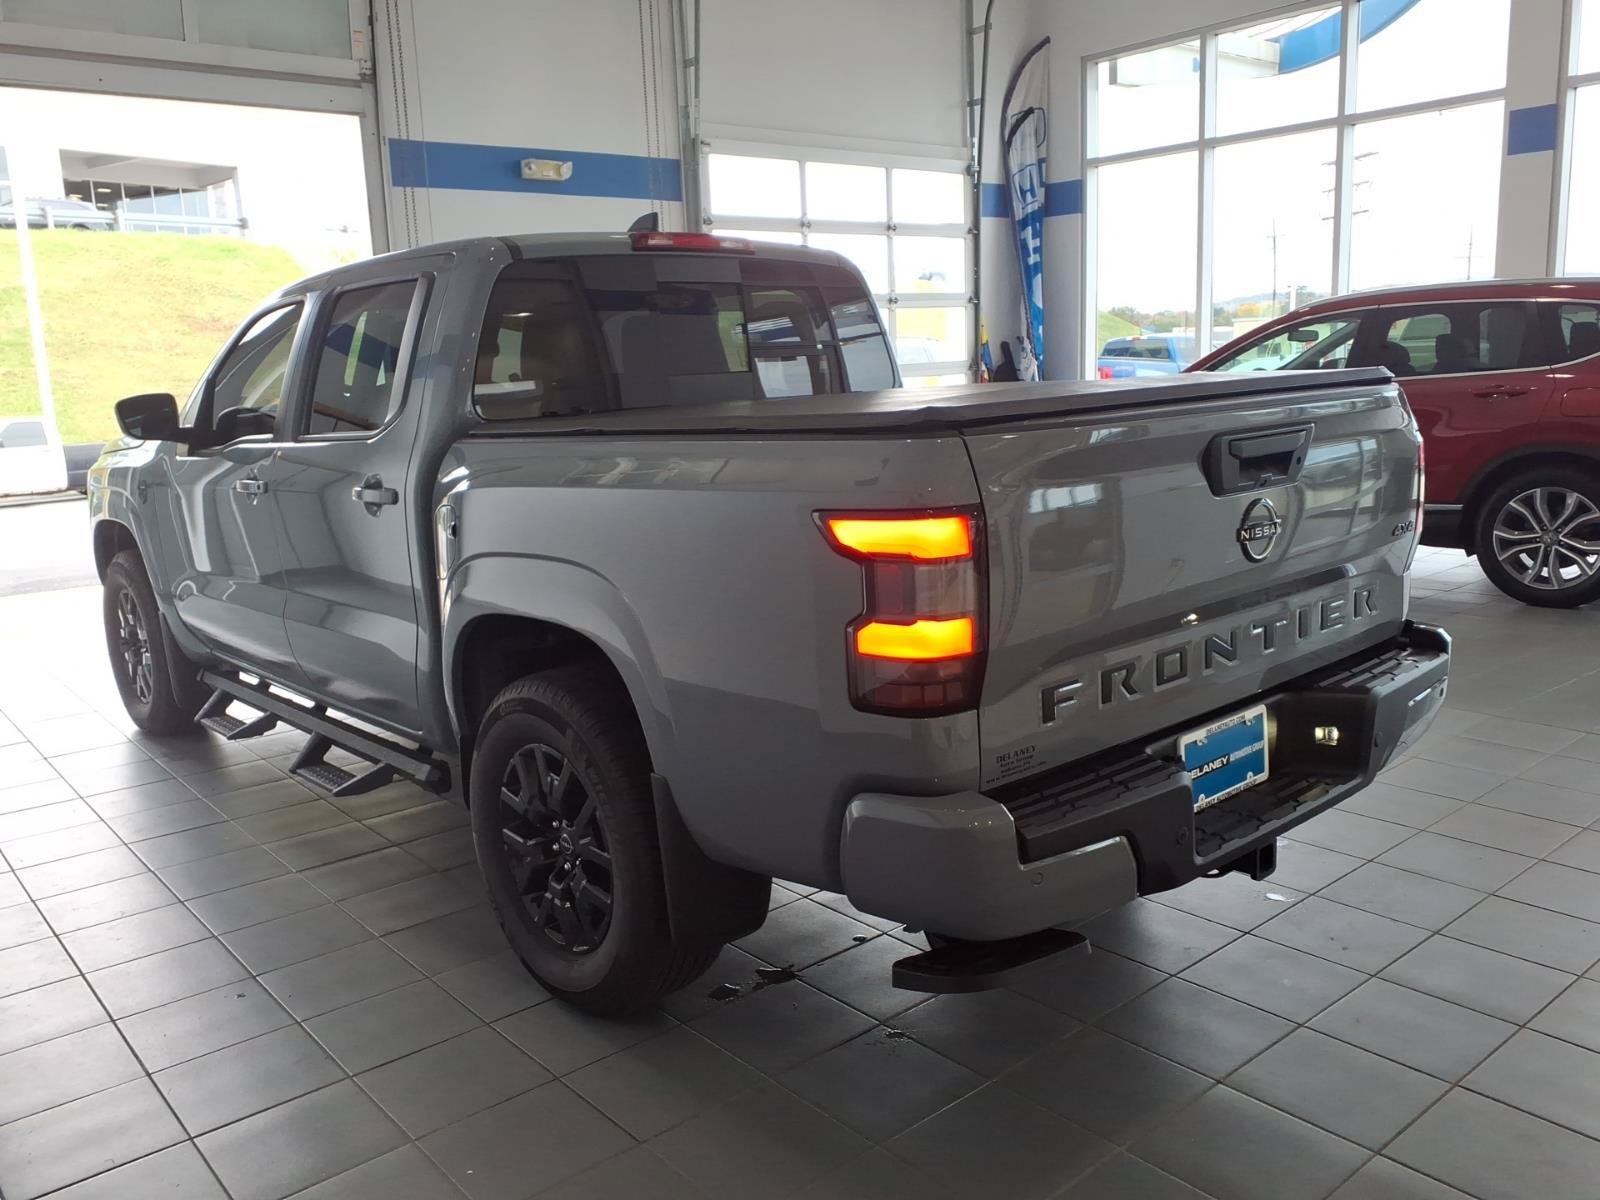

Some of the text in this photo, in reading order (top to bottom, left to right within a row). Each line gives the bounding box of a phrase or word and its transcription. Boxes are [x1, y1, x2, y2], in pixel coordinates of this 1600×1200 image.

[1240, 523, 1281, 540] NISSAN
[1040, 586, 1379, 727] FRONTIER
[996, 745, 1036, 764] DELANEY
[1190, 755, 1229, 779] ELANEY
